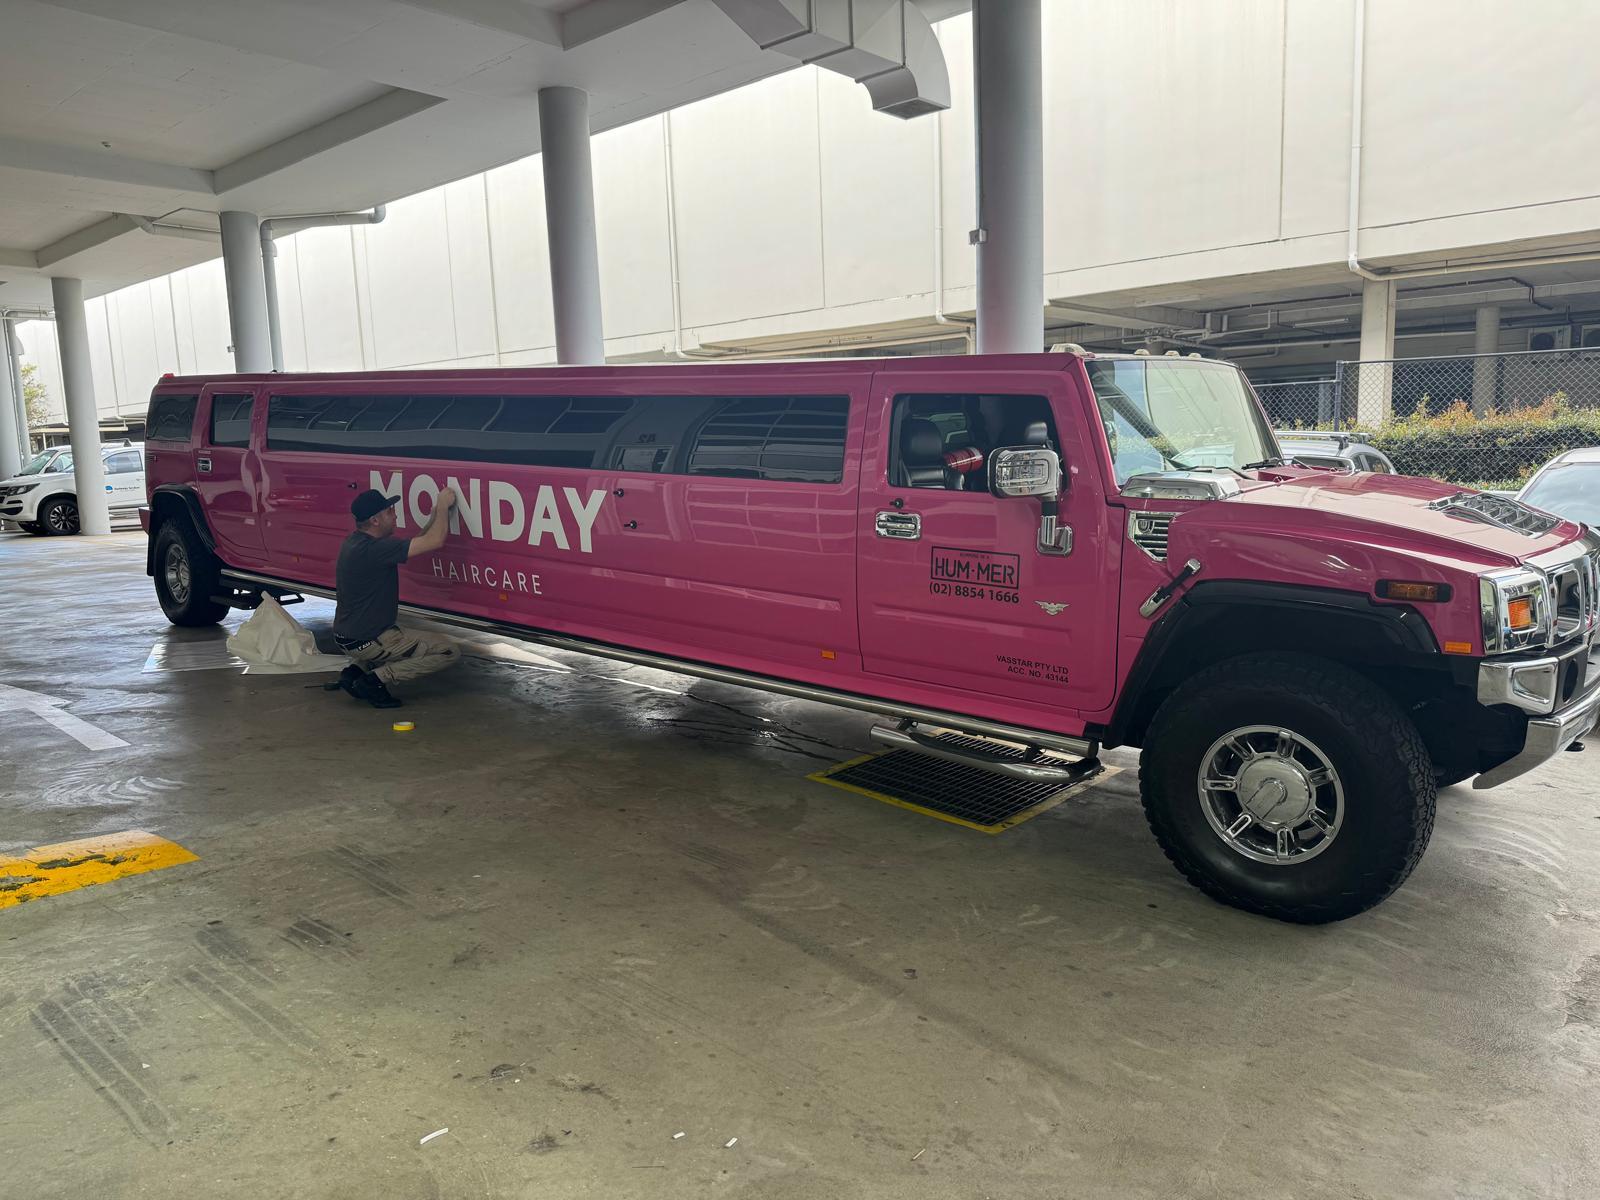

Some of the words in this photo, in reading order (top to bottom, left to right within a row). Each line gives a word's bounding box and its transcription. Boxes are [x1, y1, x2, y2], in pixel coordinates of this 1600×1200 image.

[369, 470, 607, 553] MONDAY
[431, 557, 543, 595] HAIRCARE
[929, 582, 951, 596] (02)
[955, 585, 984, 599] 8854
[988, 589, 1020, 603] 1666
[997, 655, 1033, 668] VASSTAR
[1035, 662, 1051, 670] PTY
[1053, 665, 1069, 674] LTD
[1046, 673, 1069, 683] 43144
